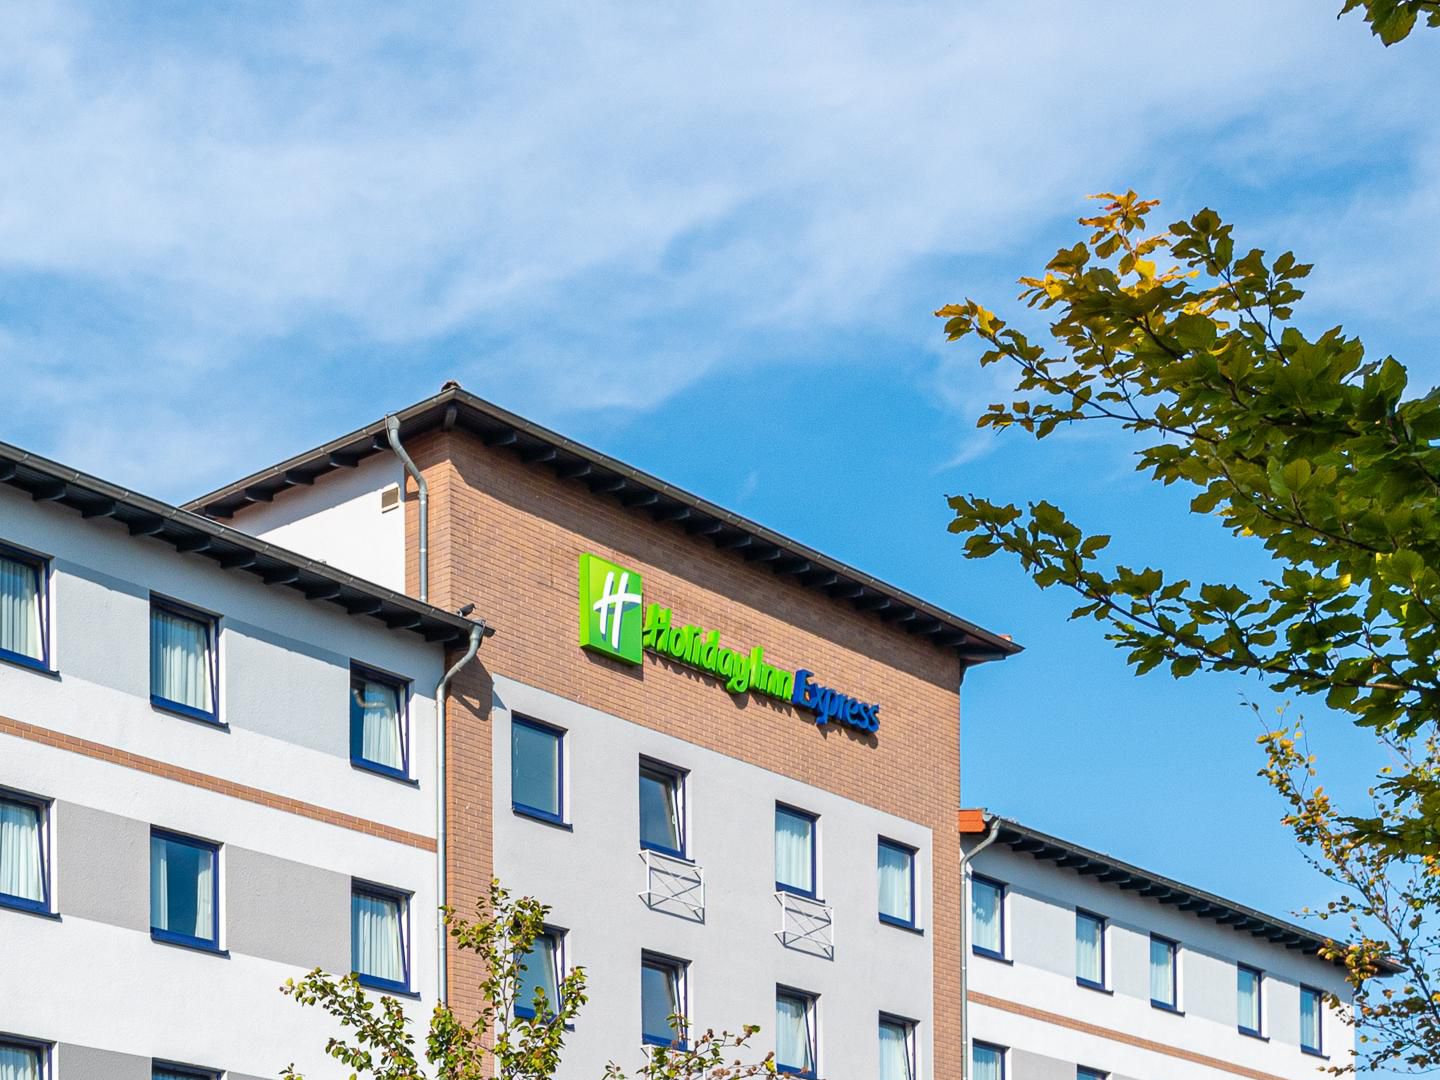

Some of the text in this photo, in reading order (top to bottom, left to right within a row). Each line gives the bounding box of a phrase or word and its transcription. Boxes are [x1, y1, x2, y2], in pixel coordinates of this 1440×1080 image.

[643, 603, 880, 733] Holiday Inn Express
